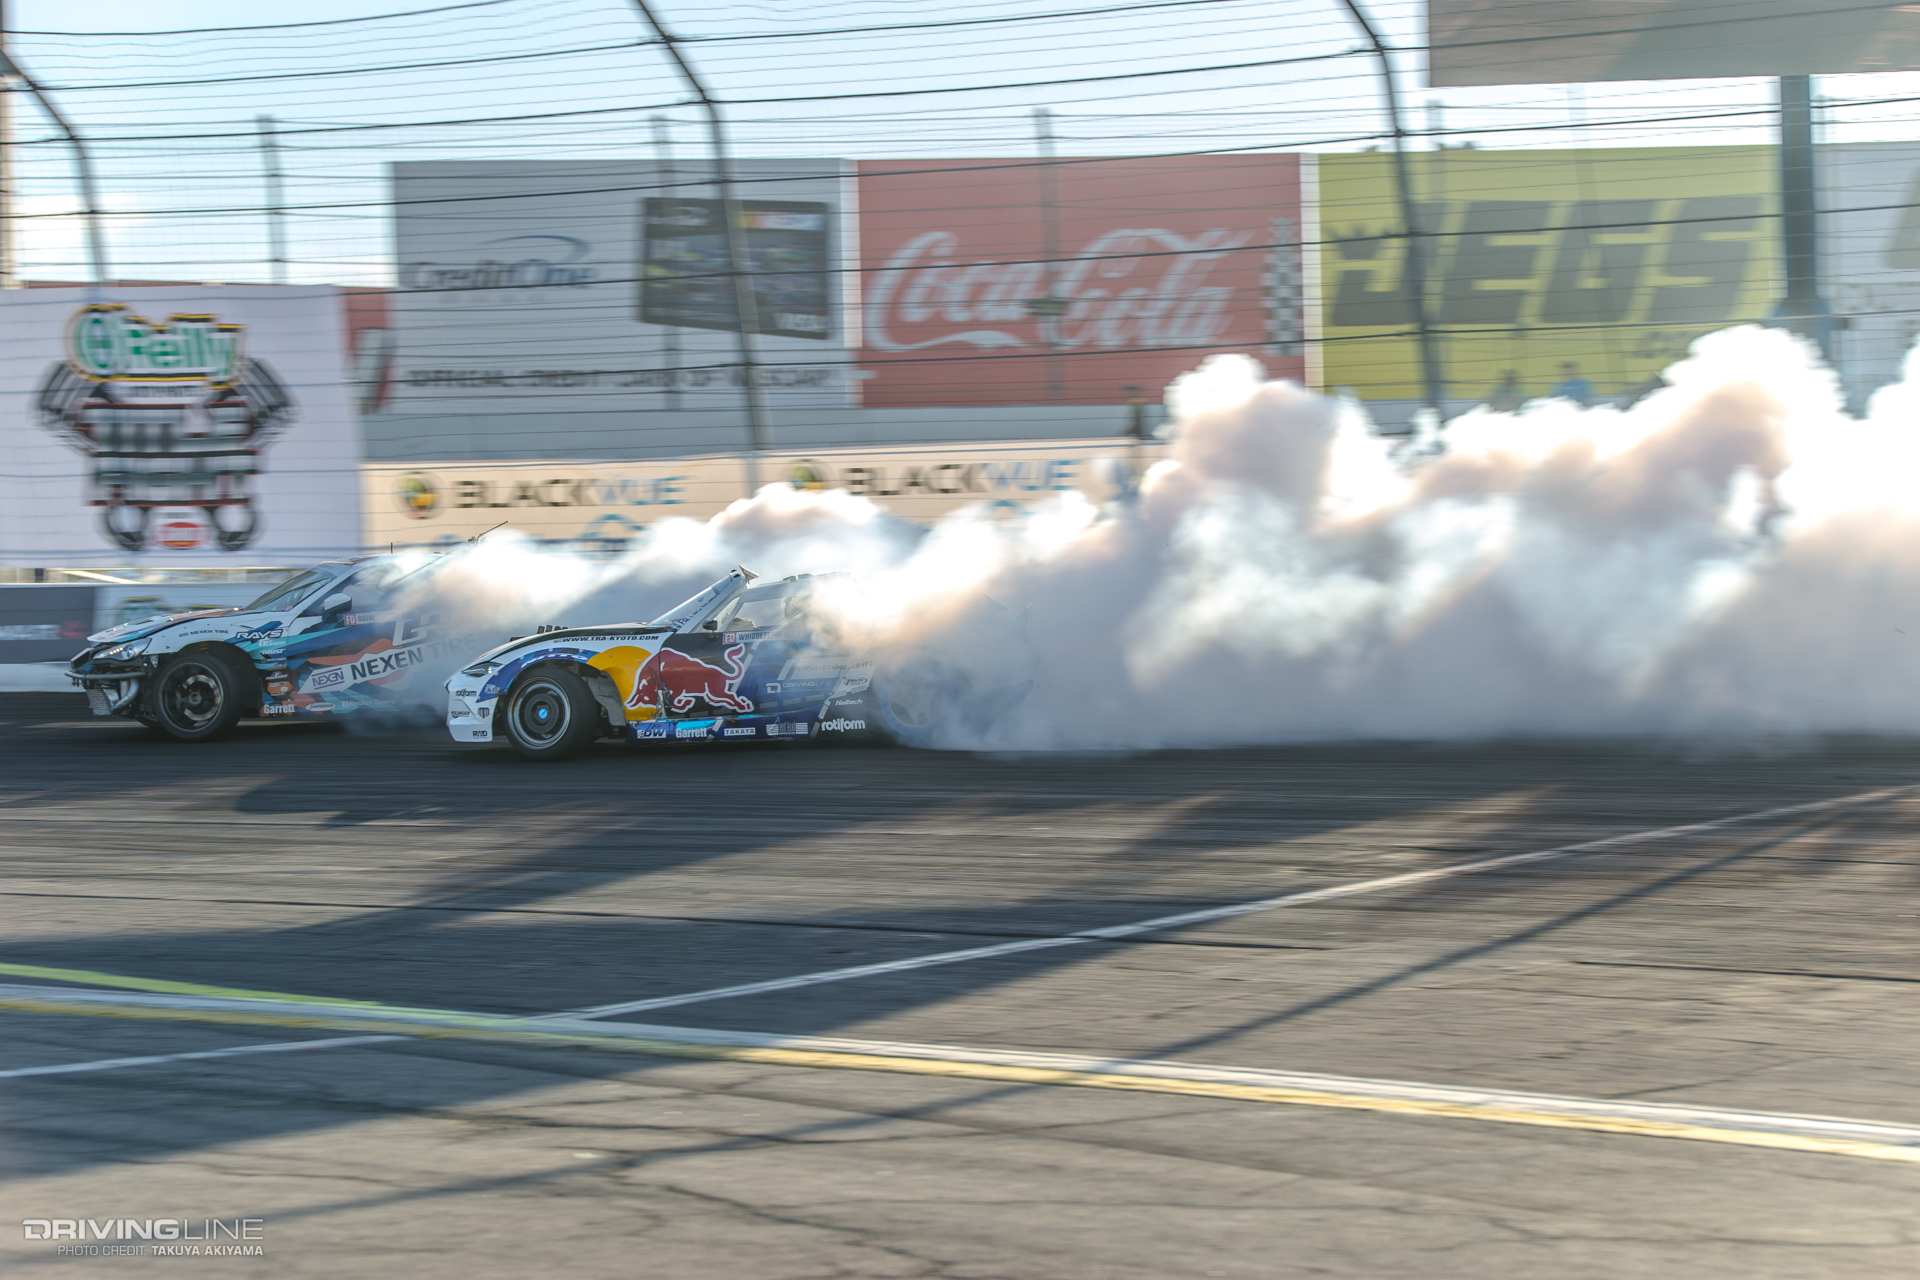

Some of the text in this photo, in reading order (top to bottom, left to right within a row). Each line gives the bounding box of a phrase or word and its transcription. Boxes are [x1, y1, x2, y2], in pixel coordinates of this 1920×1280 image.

[841, 459, 1080, 496] BLACKVUE
[452, 474, 692, 508] BLACKVUE
[358, 615, 375, 623] GUSHI
[235, 628, 284, 640] RAYS
[562, 635, 660, 643] WWW.TRA-KYOTO.COM
[350, 647, 424, 681] NEXEN
[427, 634, 478, 660] TIRE
[263, 703, 296, 715] Garrett
[821, 718, 866, 733] rotiform
[675, 727, 708, 739] Garrett
[725, 728, 755, 736] TAKATA
